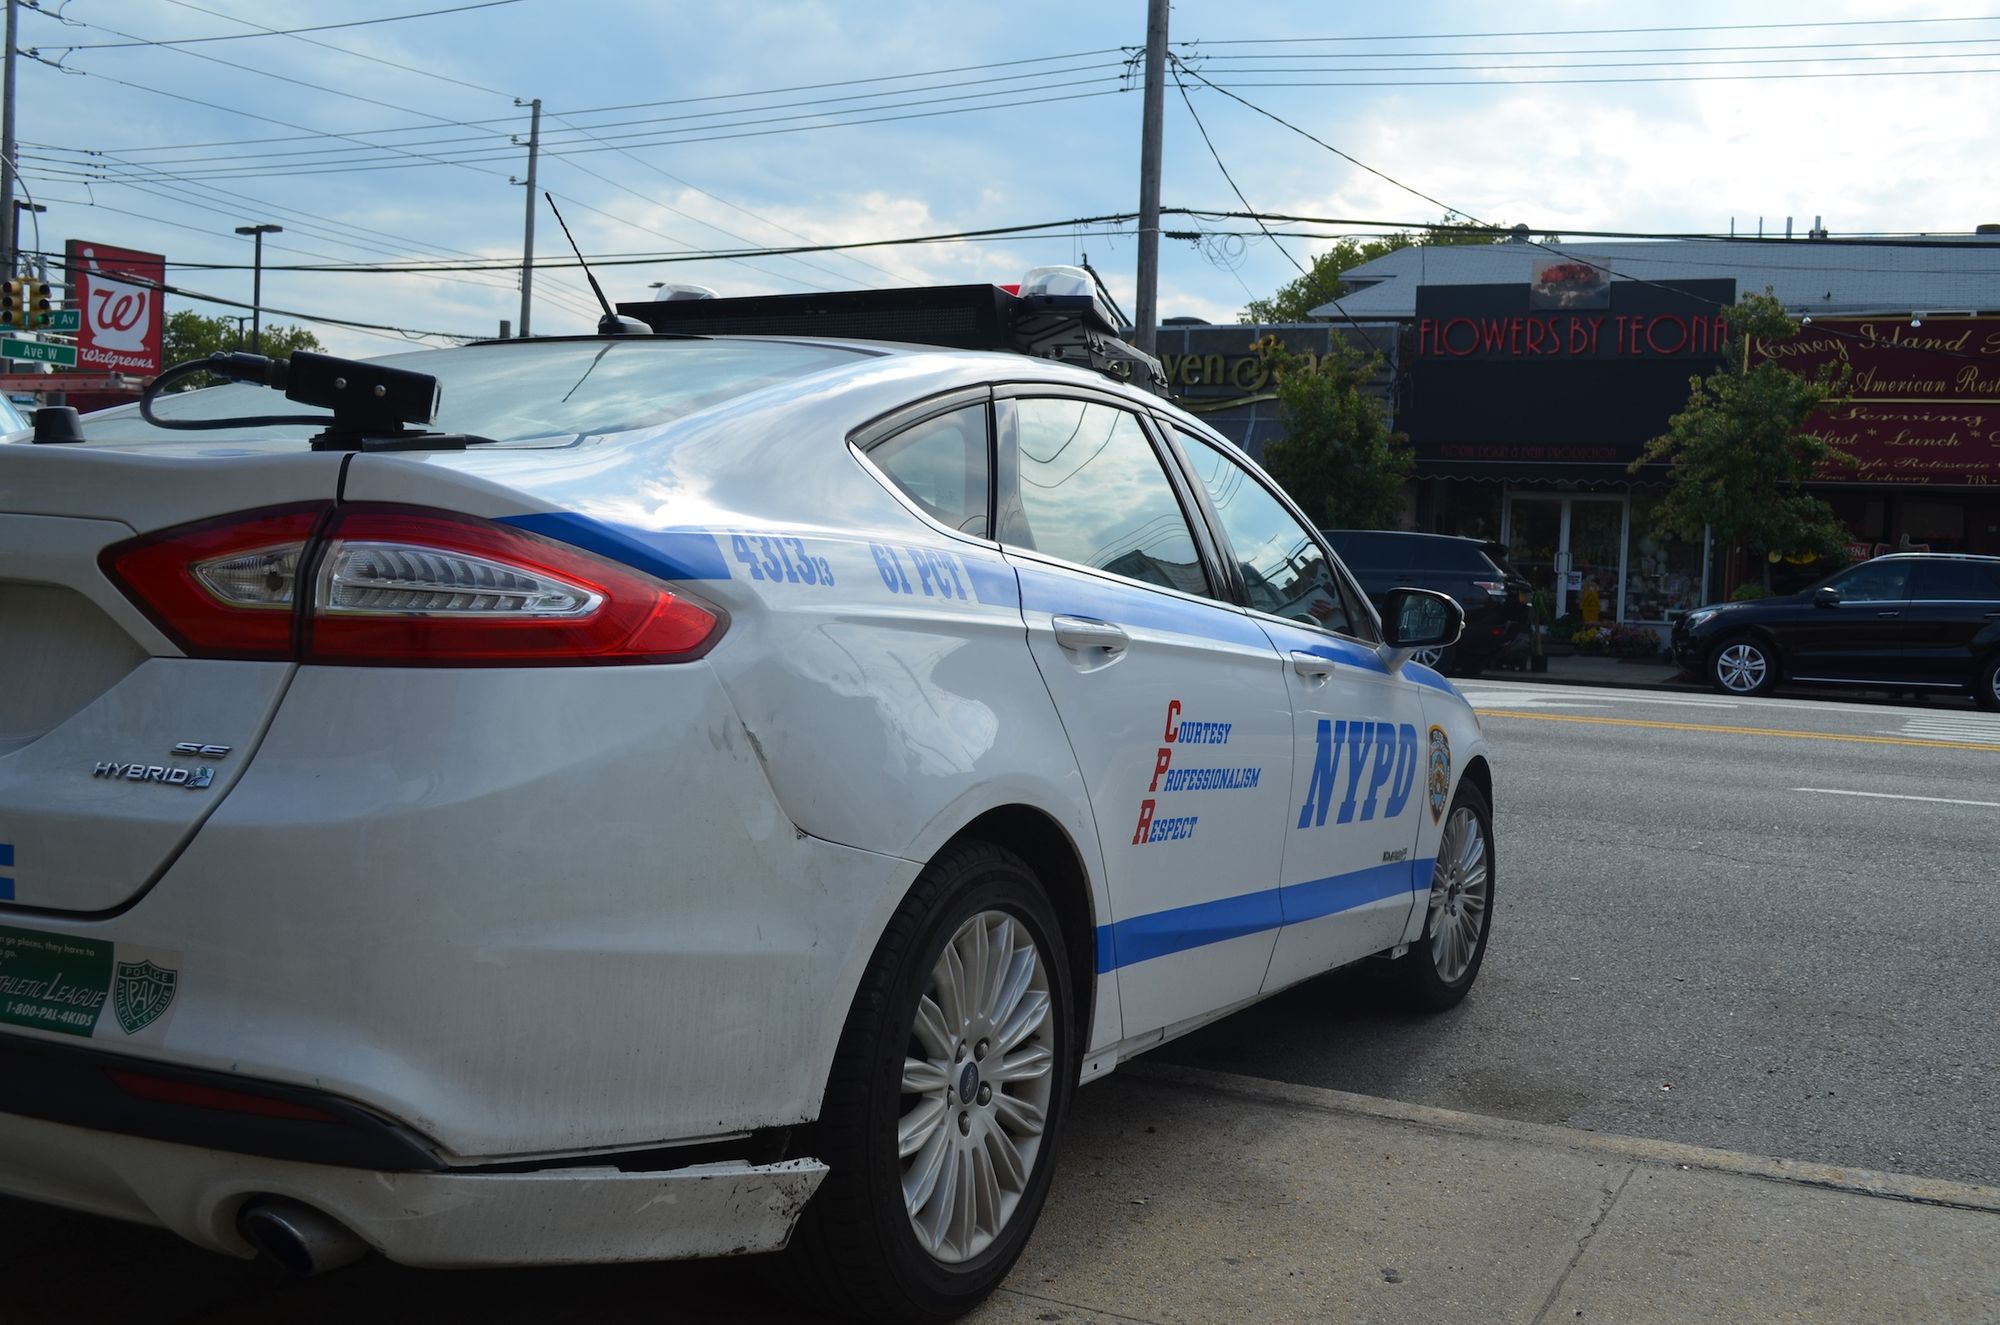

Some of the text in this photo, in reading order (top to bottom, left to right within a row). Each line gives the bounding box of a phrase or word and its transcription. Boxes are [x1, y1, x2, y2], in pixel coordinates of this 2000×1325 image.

[61, 314, 75, 325] Av
[1418, 316, 1562, 357] FLOWERS
[1568, 316, 1606, 355] BY
[1859, 323, 1973, 352] Island
[23, 344, 58, 360] Ave W
[80, 348, 155, 369] Walgreens
[1160, 352, 1225, 386] ven
[1850, 366, 1946, 394] American
[1830, 406, 1987, 427] Serving
[1884, 429, 1962, 447] Lunch
[1857, 471, 1930, 485] Delivery
[869, 540, 968, 600] 61 PCT
[1164, 699, 1232, 744] COURTESY
[169, 741, 232, 759] SE
[92, 761, 190, 785] HYBRID
[1148, 747, 1261, 792] PROFESSIONALISM
[1297, 719, 1417, 830] NYPD
[1132, 799, 1198, 845] RESPECT
[45, 941, 63, 953] they
[64, 944, 84, 956] have
[126, 967, 169, 982] POLICE
[43, 972, 107, 1008] LEAGUE
[117, 981, 133, 1026] ATHLETIC
[130, 980, 157, 1010] PAL
[6, 1001, 94, 1026] 1-800-PAL-4KIDS
[136, 989, 170, 1026] LEAGUE
